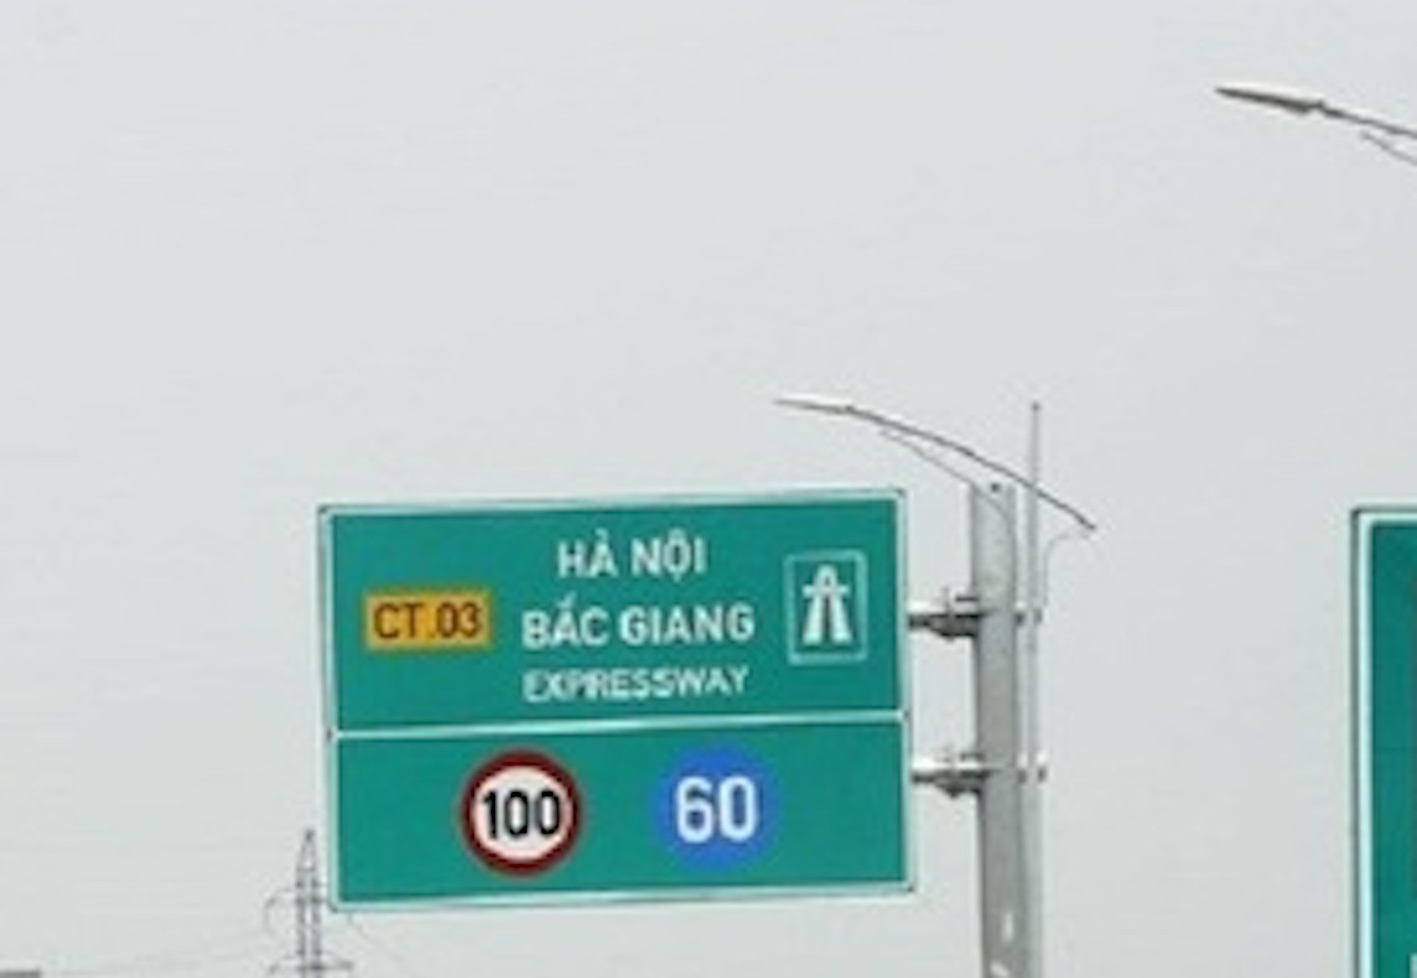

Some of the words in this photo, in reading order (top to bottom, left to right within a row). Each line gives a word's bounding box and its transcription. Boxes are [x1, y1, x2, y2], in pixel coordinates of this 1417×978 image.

[632, 527, 707, 582] NỘI
[374, 602, 481, 639] CT.03
[522, 591, 610, 649] BẮC
[619, 602, 756, 645] GIANG
[522, 664, 749, 702] EXPRESSWAY
[481, 790, 561, 839] 100
[676, 776, 758, 843] 60
